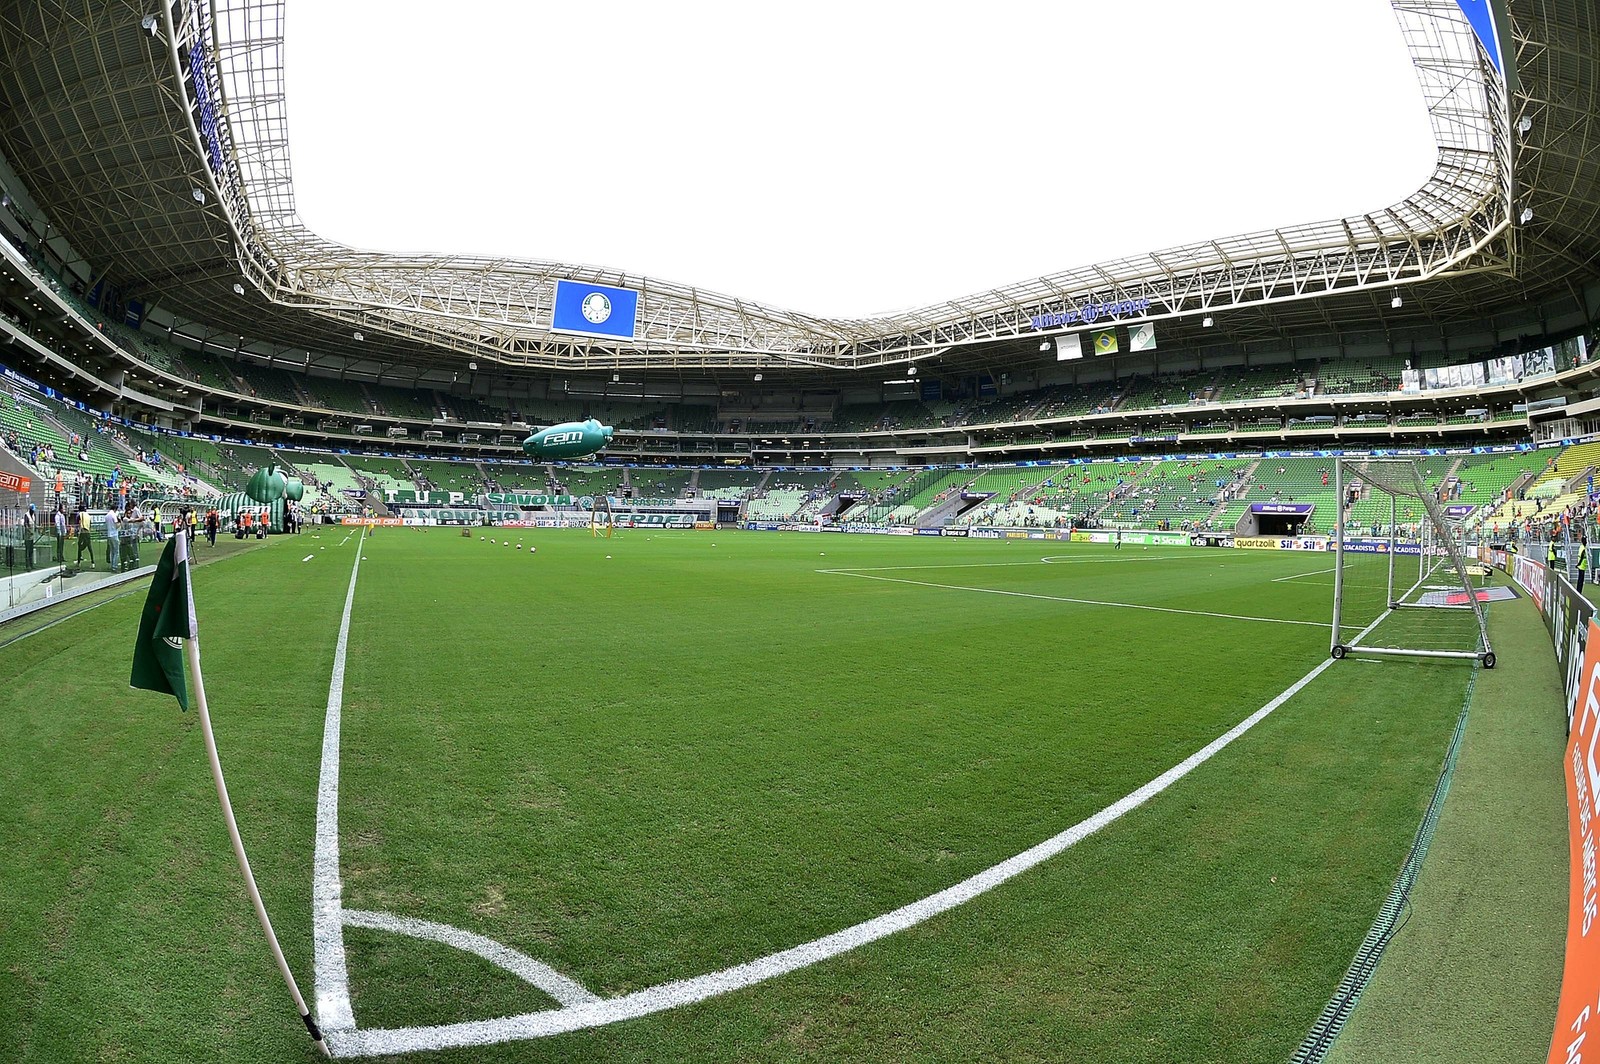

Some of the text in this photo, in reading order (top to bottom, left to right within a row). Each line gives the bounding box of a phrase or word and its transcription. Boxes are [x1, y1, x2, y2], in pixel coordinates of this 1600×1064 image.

[1030, 298, 1151, 330] Allianz Parque
[0, 474, 20, 487] am
[486, 493, 572, 505] SAVOIA
[968, 529, 999, 539] Balalaika
[1121, 534, 1146, 543] Sicredi
[1162, 536, 1187, 545] Sicredi
[1236, 539, 1276, 550] quartzolit
[1280, 540, 1293, 549] Sil
[1303, 541, 1316, 550] Sil
